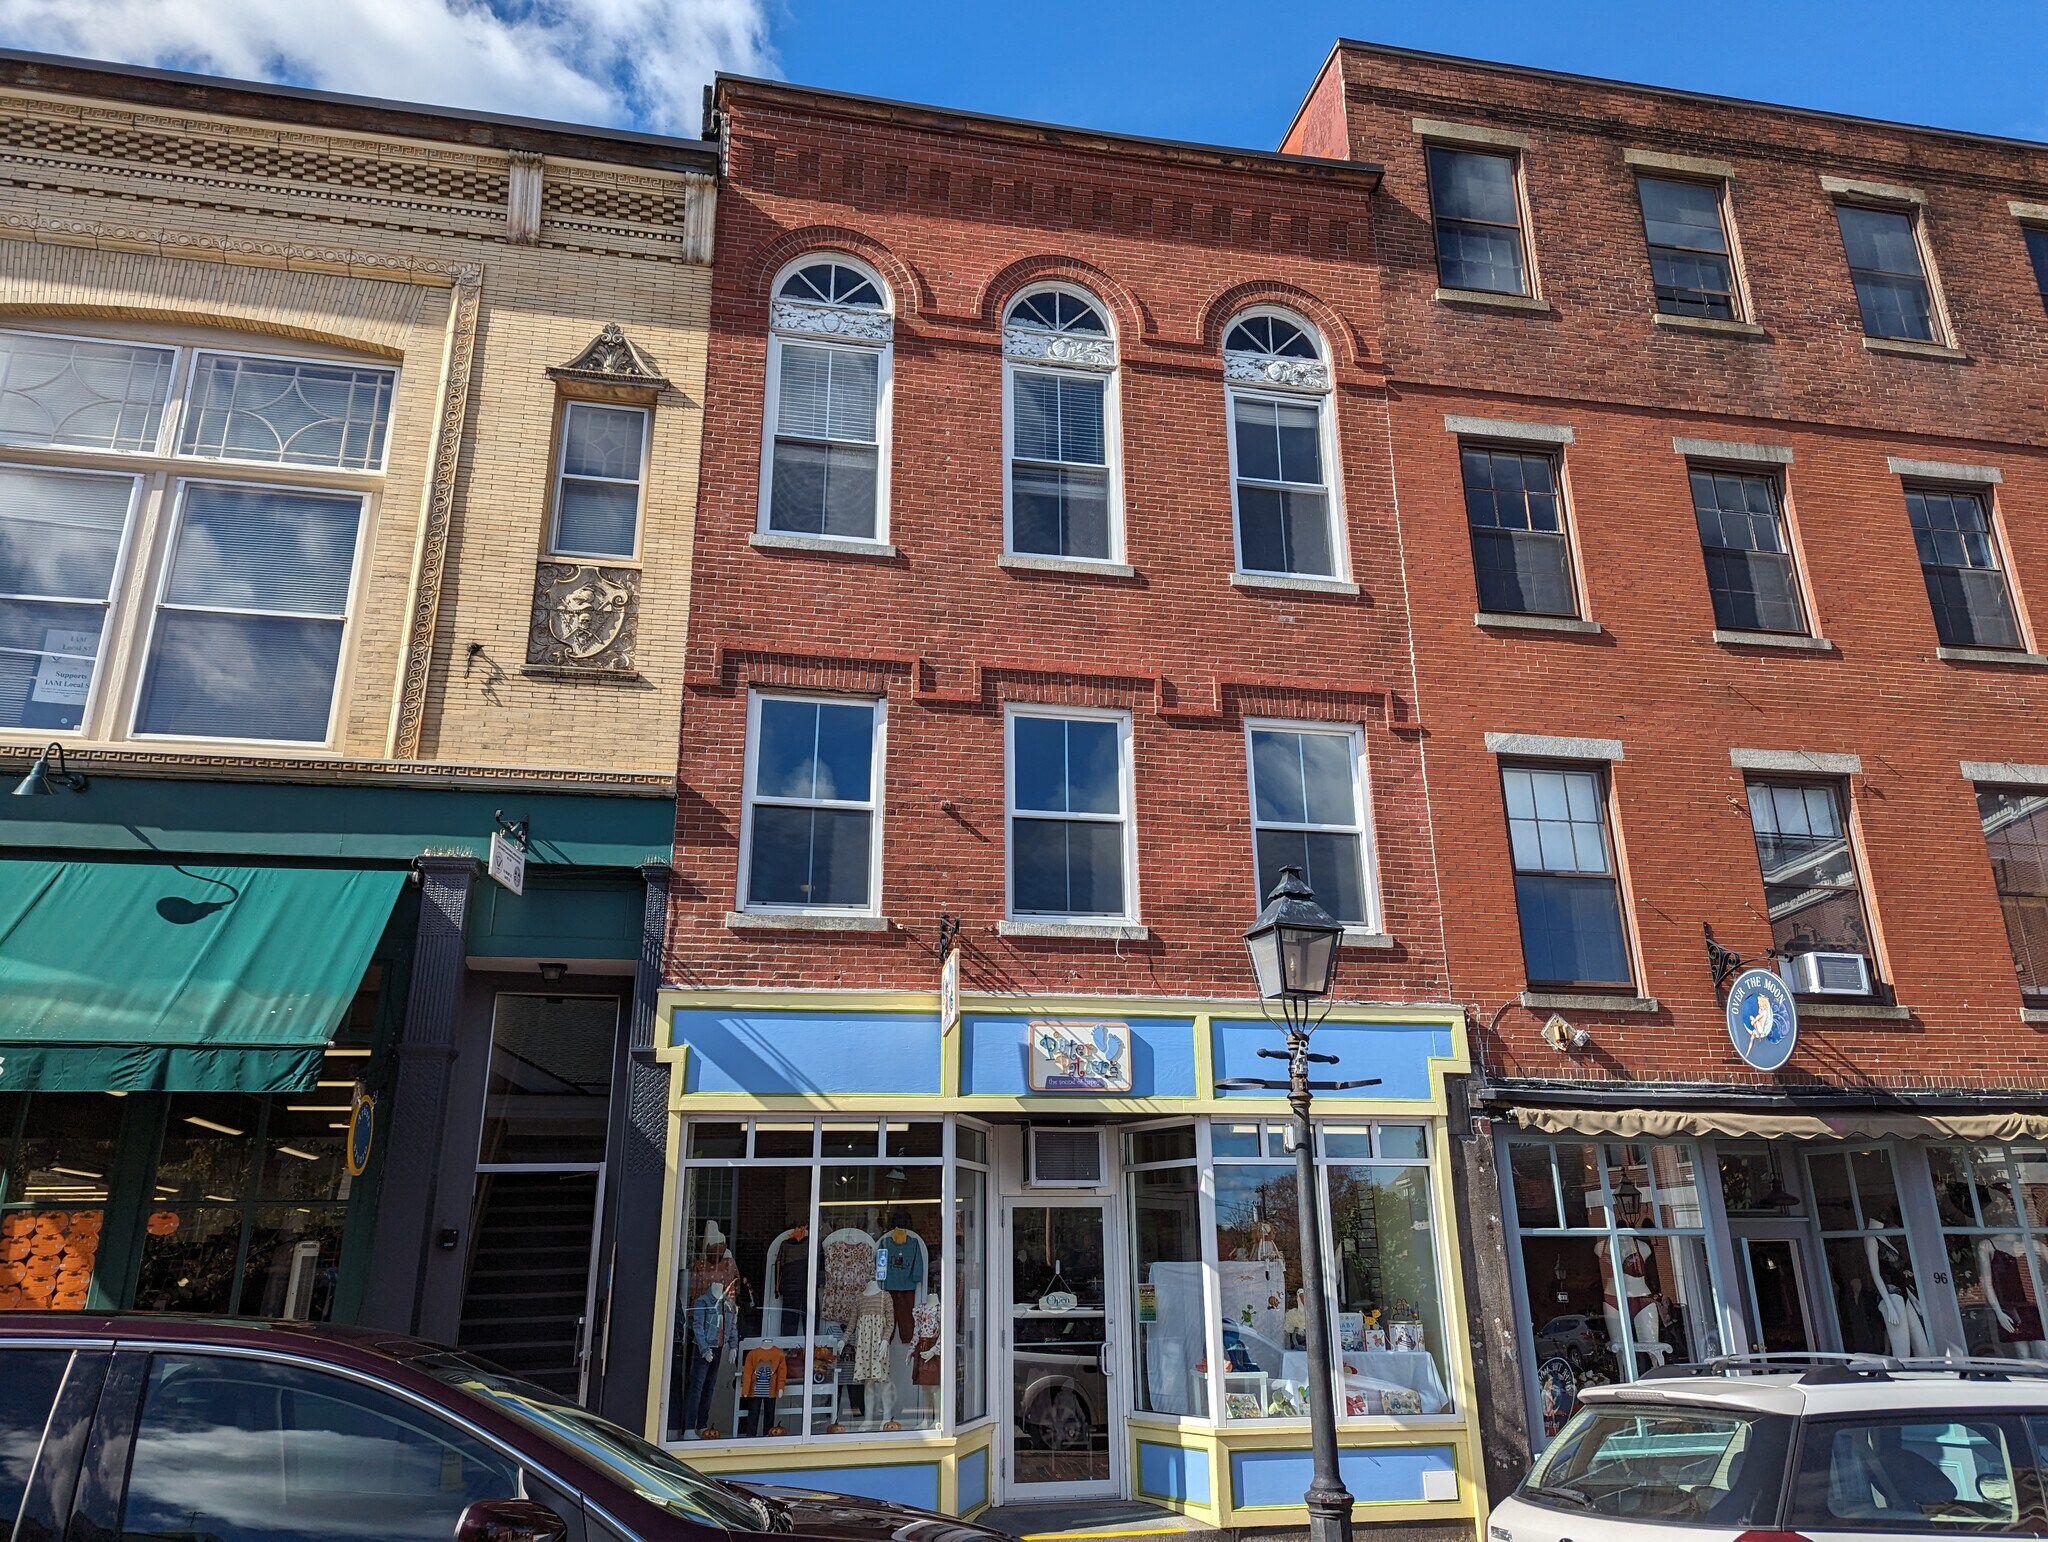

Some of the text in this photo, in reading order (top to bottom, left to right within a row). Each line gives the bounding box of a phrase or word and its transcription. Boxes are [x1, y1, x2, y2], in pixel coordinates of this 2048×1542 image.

[56, 671, 87, 680] Supports
[1731, 976, 1785, 1015] OVER THE MOON
[1040, 1031, 1094, 1061] Pitter
[1055, 1053, 1109, 1077] Patter
[1933, 1271, 1948, 1285] 96
[1046, 1295, 1070, 1307] Open
